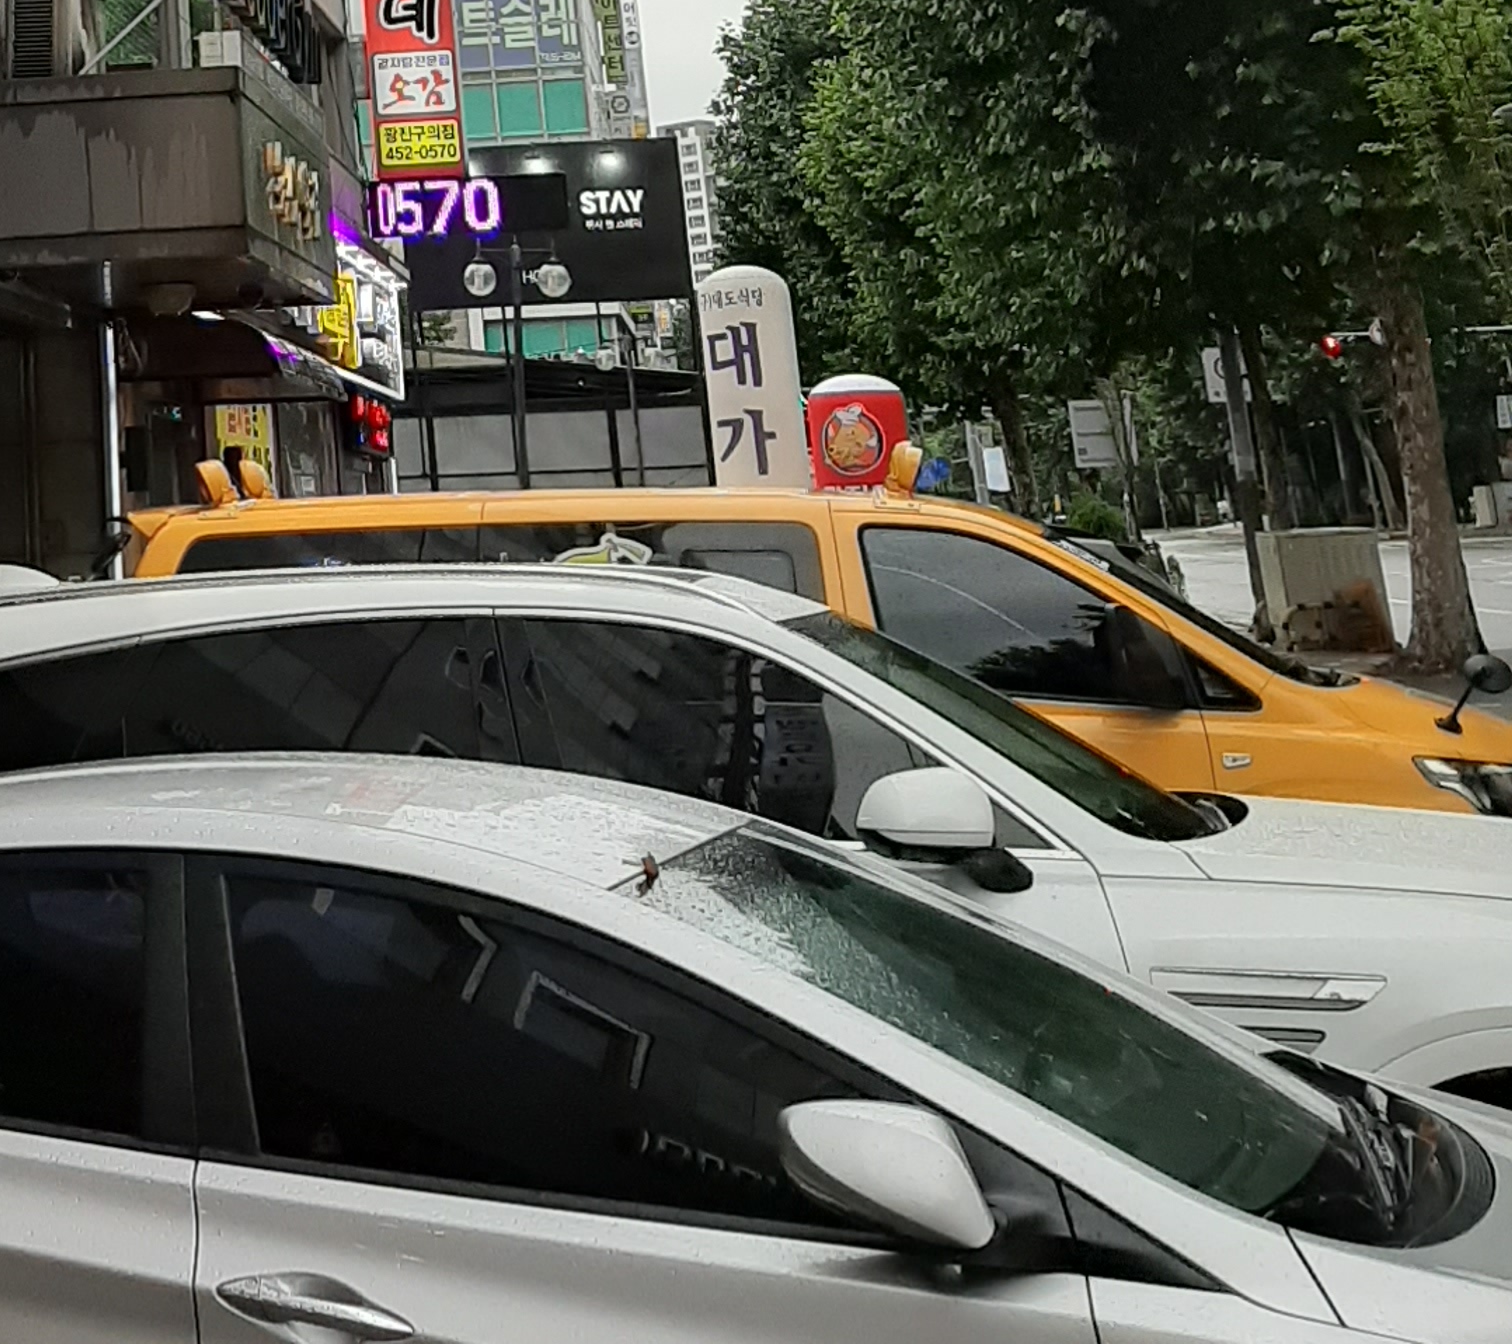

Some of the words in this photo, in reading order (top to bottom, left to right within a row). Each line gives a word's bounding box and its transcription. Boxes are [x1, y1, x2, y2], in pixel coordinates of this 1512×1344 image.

[385, 143, 458, 162] 452-0570
[377, 178, 501, 235] 0570
[579, 189, 645, 215] STAY
[705, 320, 778, 477] 대가
